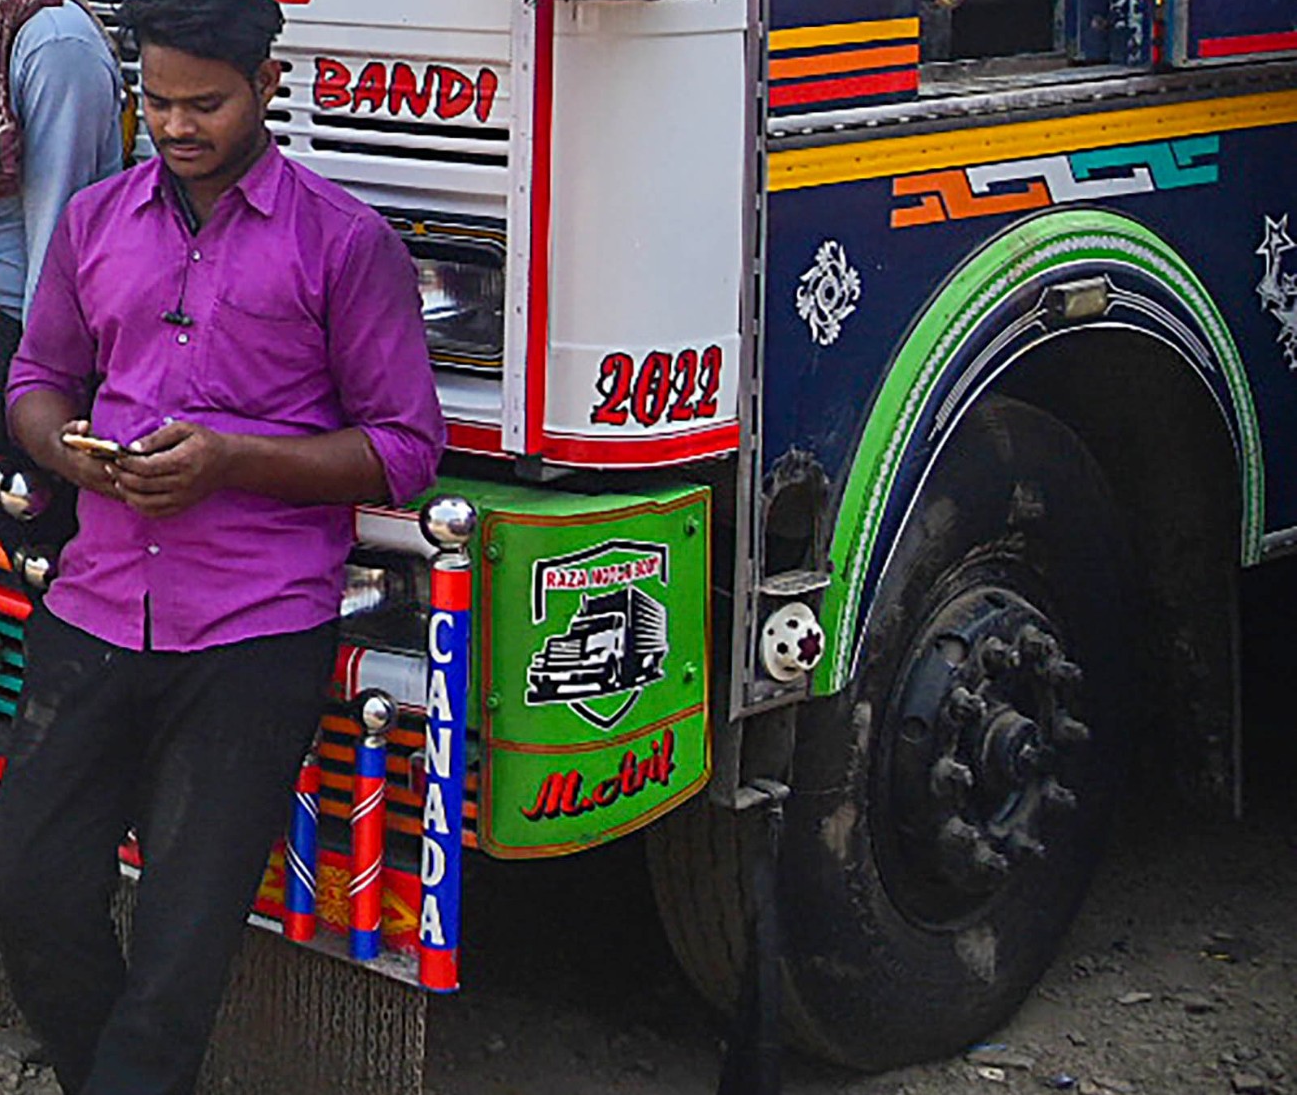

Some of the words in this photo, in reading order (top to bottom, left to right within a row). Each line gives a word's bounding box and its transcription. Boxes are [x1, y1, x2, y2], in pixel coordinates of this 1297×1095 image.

[311, 57, 499, 125] BANDI
[589, 345, 724, 428] 2022
[546, 569, 588, 588] RAZA
[418, 611, 455, 947] CANADA
